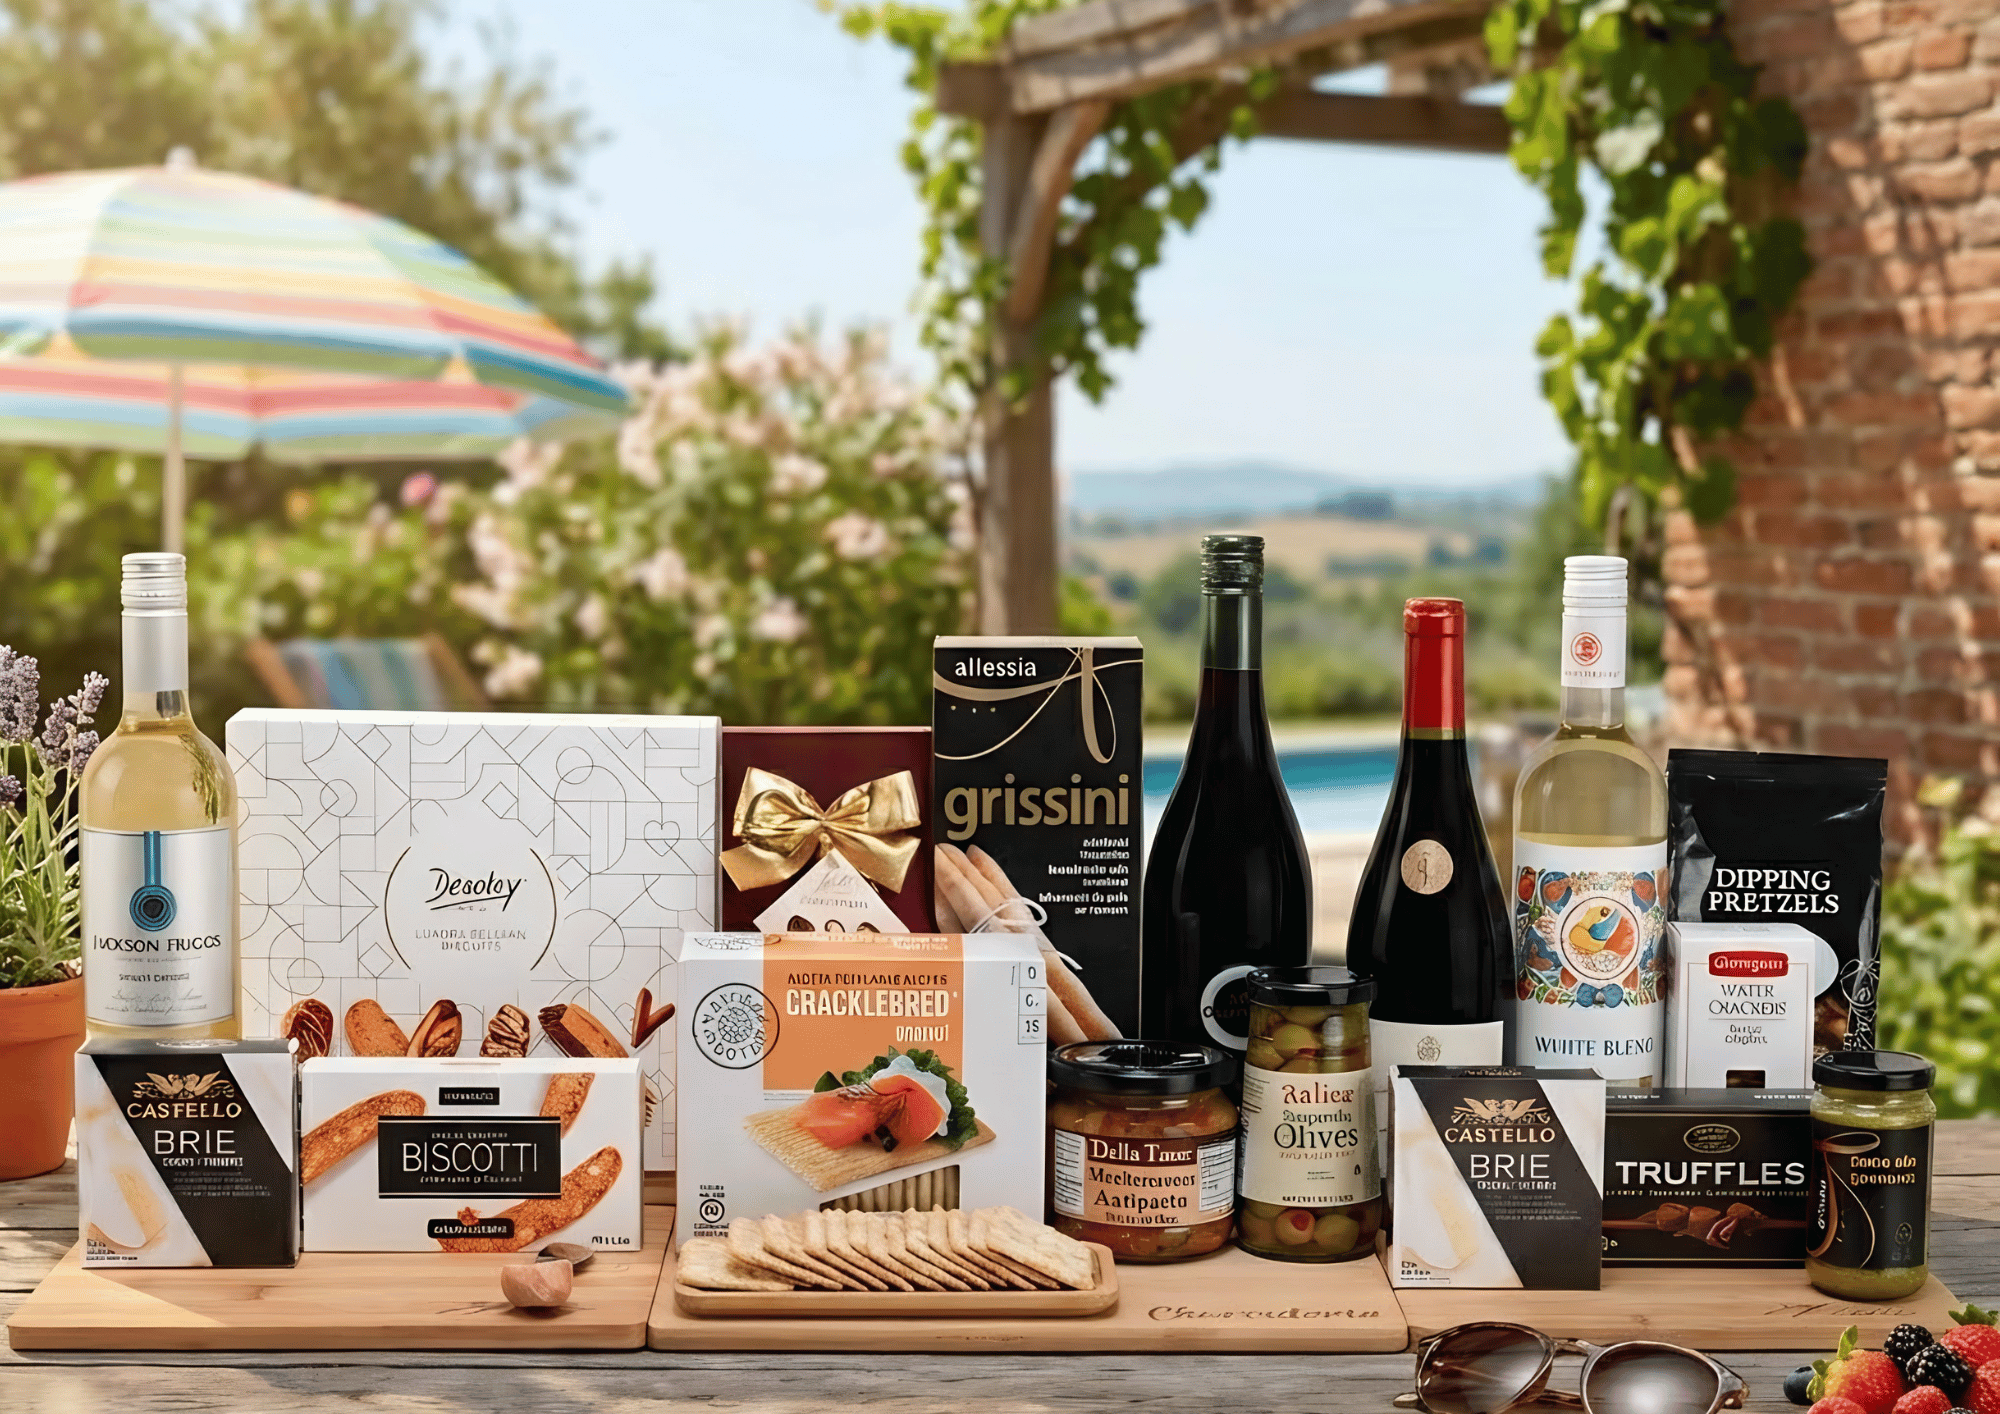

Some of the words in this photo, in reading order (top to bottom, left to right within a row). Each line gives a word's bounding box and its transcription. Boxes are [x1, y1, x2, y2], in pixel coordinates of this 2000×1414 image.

[955, 657, 1037, 677] allessia
[944, 773, 1129, 841] grissini
[1715, 868, 1831, 891] DIPPING
[1708, 891, 1840, 914] PRETZELS
[786, 988, 950, 1017] CRACKLEBRED
[154, 1130, 236, 1154] BRIE
[1444, 1127, 1556, 1143] CASTELLO
[402, 1142, 537, 1172] BISCOTTI
[1470, 1154, 1550, 1179] BRIE
[1615, 1161, 1805, 1185] TRUFFLES
